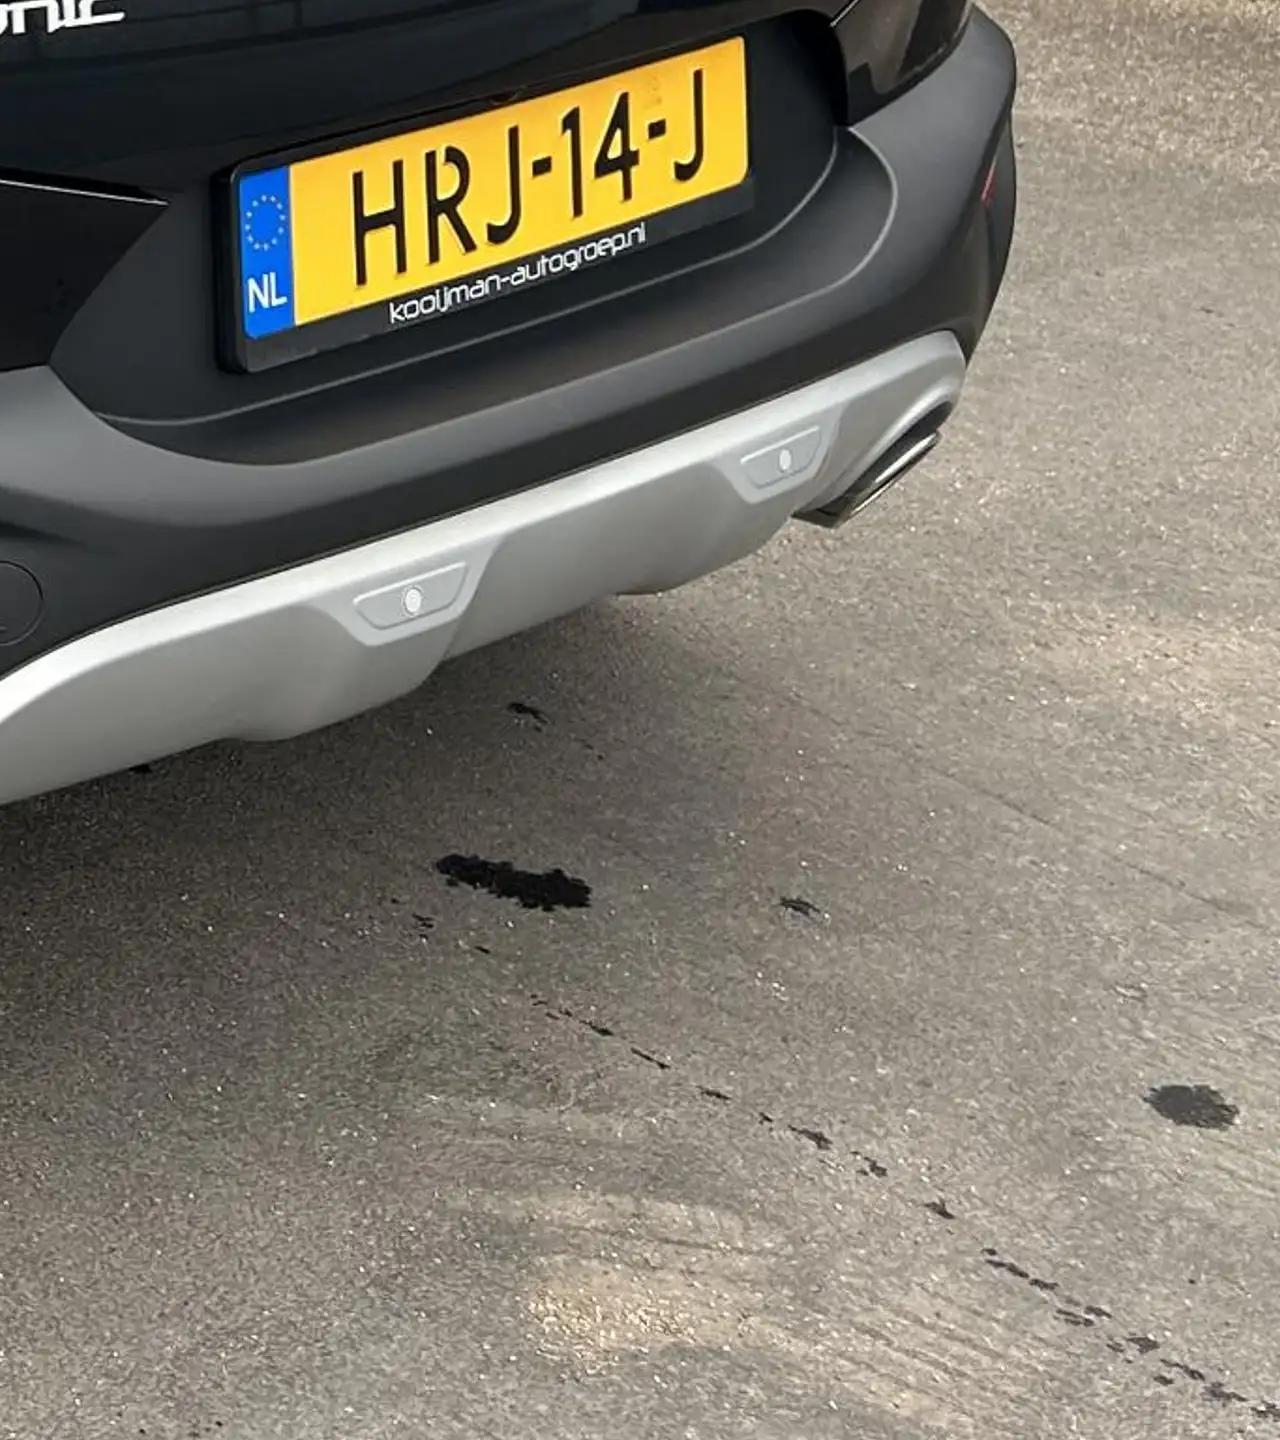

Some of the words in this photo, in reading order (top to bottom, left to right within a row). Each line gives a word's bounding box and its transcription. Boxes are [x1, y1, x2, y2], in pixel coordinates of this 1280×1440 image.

[351, 69, 704, 286] HRJ-14-J
[247, 271, 288, 315] NL
[388, 221, 646, 325] kooijman-autogroep.nl
